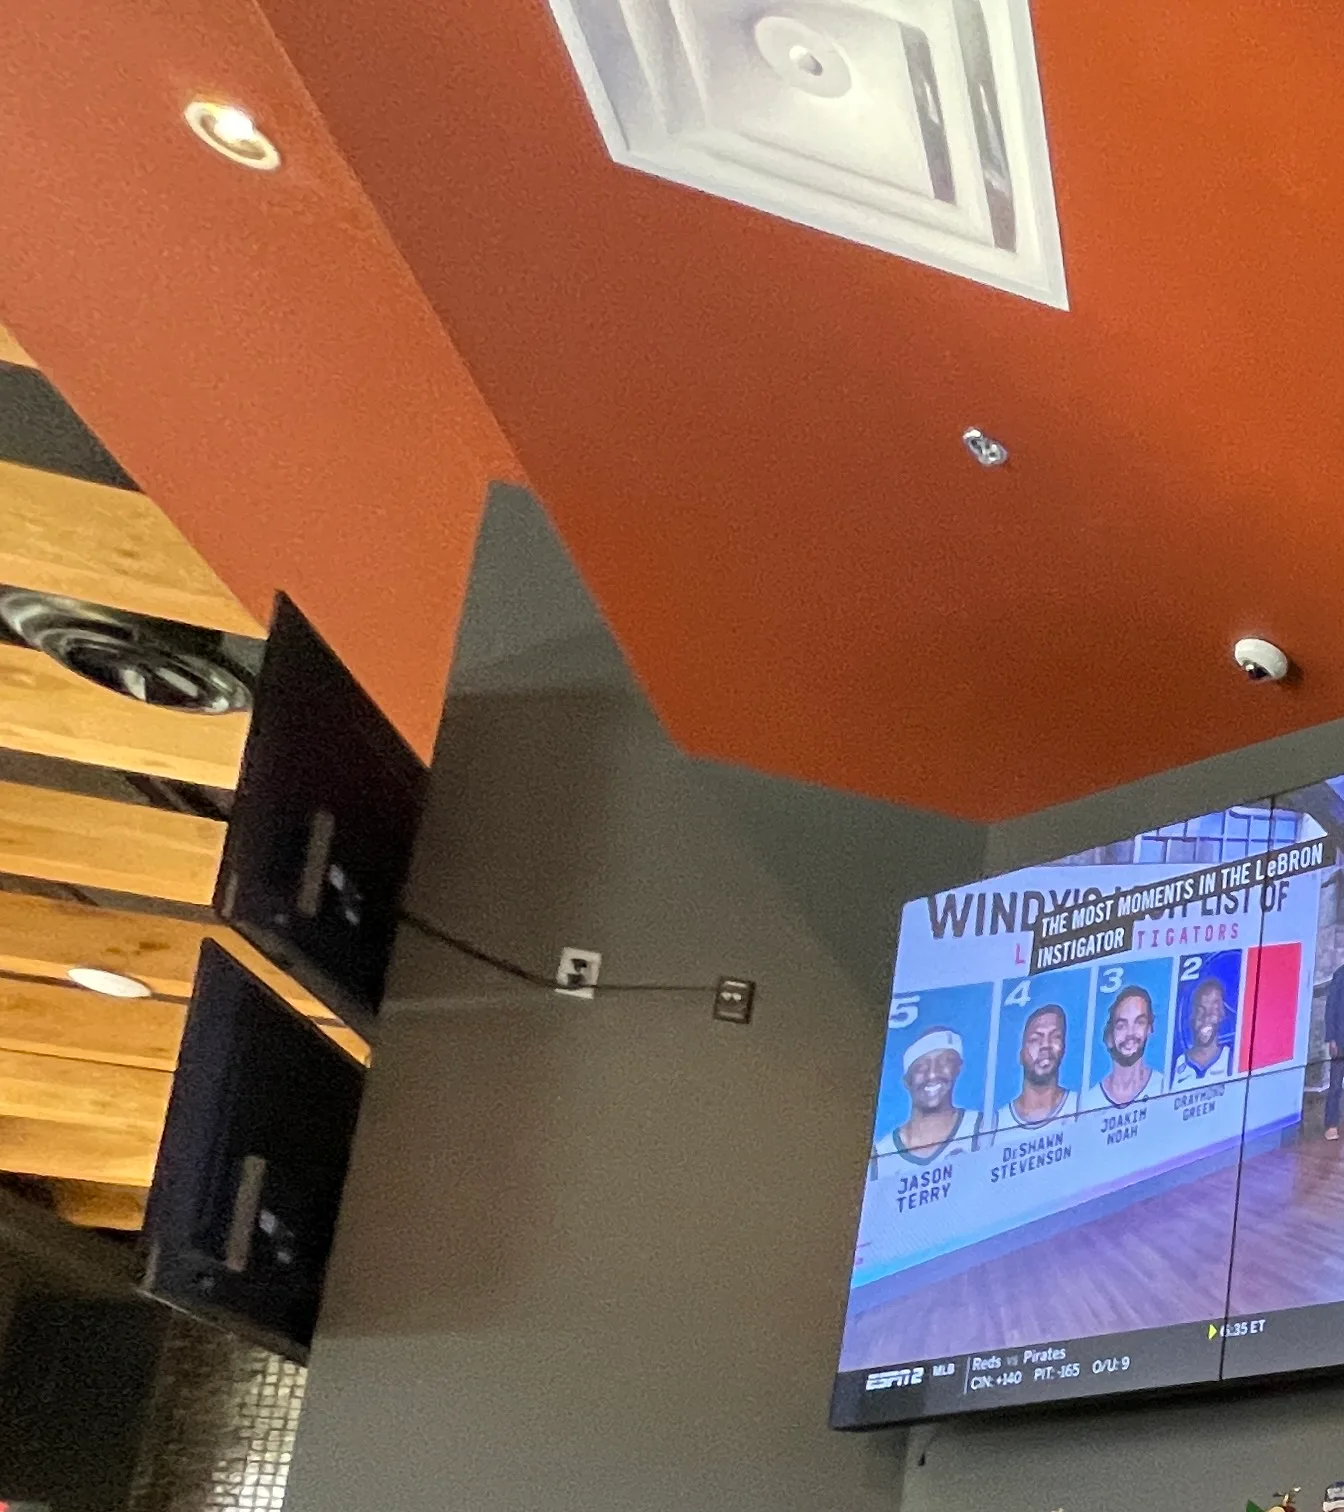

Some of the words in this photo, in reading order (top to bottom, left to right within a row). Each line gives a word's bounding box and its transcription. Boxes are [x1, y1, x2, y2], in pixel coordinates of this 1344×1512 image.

[1042, 912, 1068, 938] THE
[1072, 900, 1114, 930] MOST
[1117, 878, 1194, 917] MOMENTS
[1198, 872, 1216, 895] IN
[1221, 863, 1250, 889] THE
[1256, 842, 1323, 881] LeBRON
[1260, 880, 1290, 912] OF
[1037, 927, 1125, 968] INSTIGATOR
[1137, 923, 1239, 949] TIGATORS
[1100, 967, 1125, 994] 3
[1180, 957, 1202, 981] 2
[1003, 981, 1031, 1007] 4
[888, 996, 921, 1028] 5
[1100, 1108, 1147, 1133] JOAKIM
[1183, 1102, 1216, 1121] GREEN
[1106, 1126, 1138, 1145] NOAH
[991, 1145, 1072, 1183] STEVENSON
[898, 1164, 953, 1195] JASON
[897, 1183, 952, 1213] TERRY
[1250, 1319, 1266, 1333] ET
[972, 1356, 1001, 1371] Reds
[1023, 1347, 1066, 1364] Pirates
